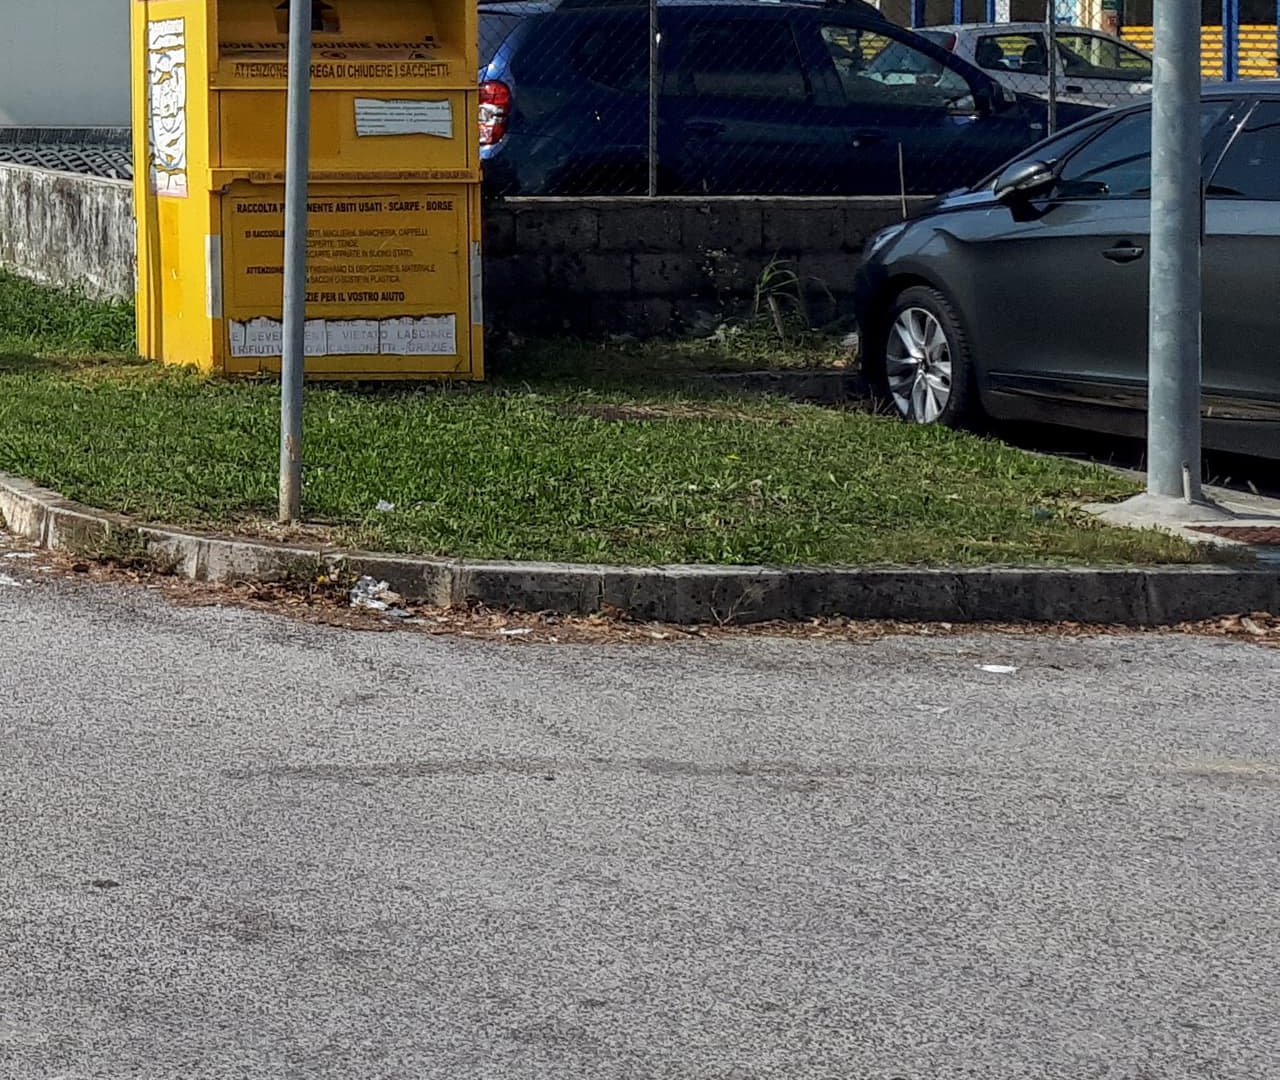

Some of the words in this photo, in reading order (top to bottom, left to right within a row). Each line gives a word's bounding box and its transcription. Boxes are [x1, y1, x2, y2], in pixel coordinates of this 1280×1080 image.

[309, 64, 335, 78] REGA
[337, 64, 347, 78] DI
[348, 64, 393, 78] CHIUDERE
[400, 63, 449, 78] SACCHETTI
[237, 203, 278, 213] RACCOLTA
[335, 202, 357, 212] ABITI
[358, 202, 382, 212] USATI
[388, 201, 420, 212] SCARPE
[426, 201, 453, 211] BORSE
[320, 292, 336, 302] PER
[347, 292, 380, 302] VOSTRO
[381, 291, 405, 302] AIUTO
